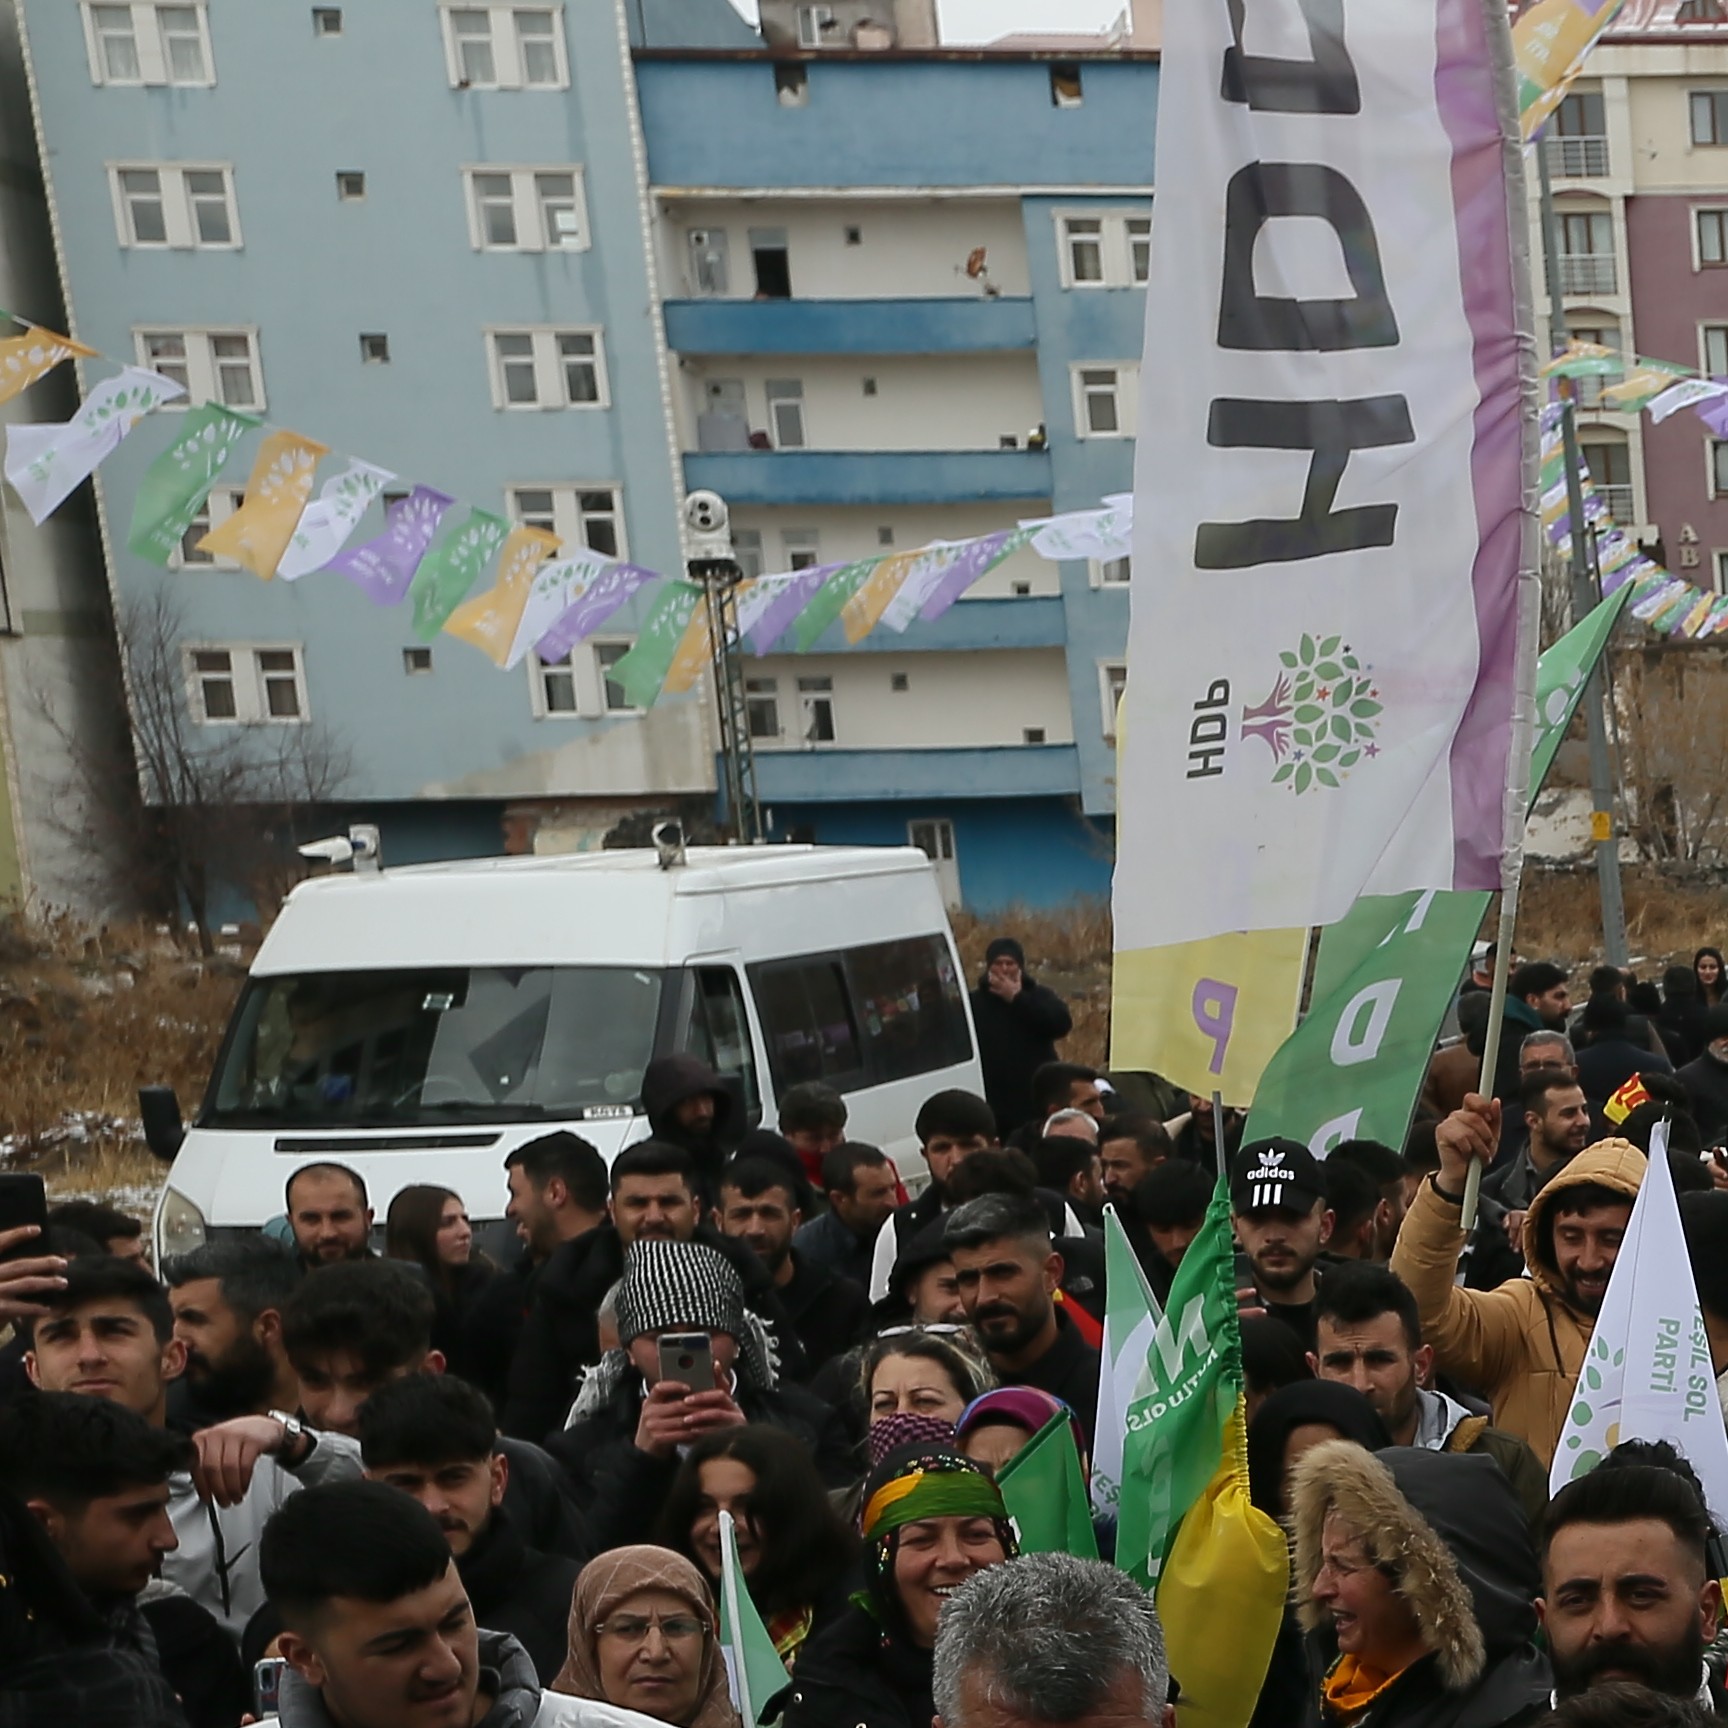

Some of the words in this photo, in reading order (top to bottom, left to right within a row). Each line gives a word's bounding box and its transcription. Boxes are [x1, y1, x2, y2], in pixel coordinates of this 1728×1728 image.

[1247, 1166, 1295, 1181] adidas
[1650, 1317, 1682, 1393] PARTİ
[1683, 1375, 1708, 1422] SOL
